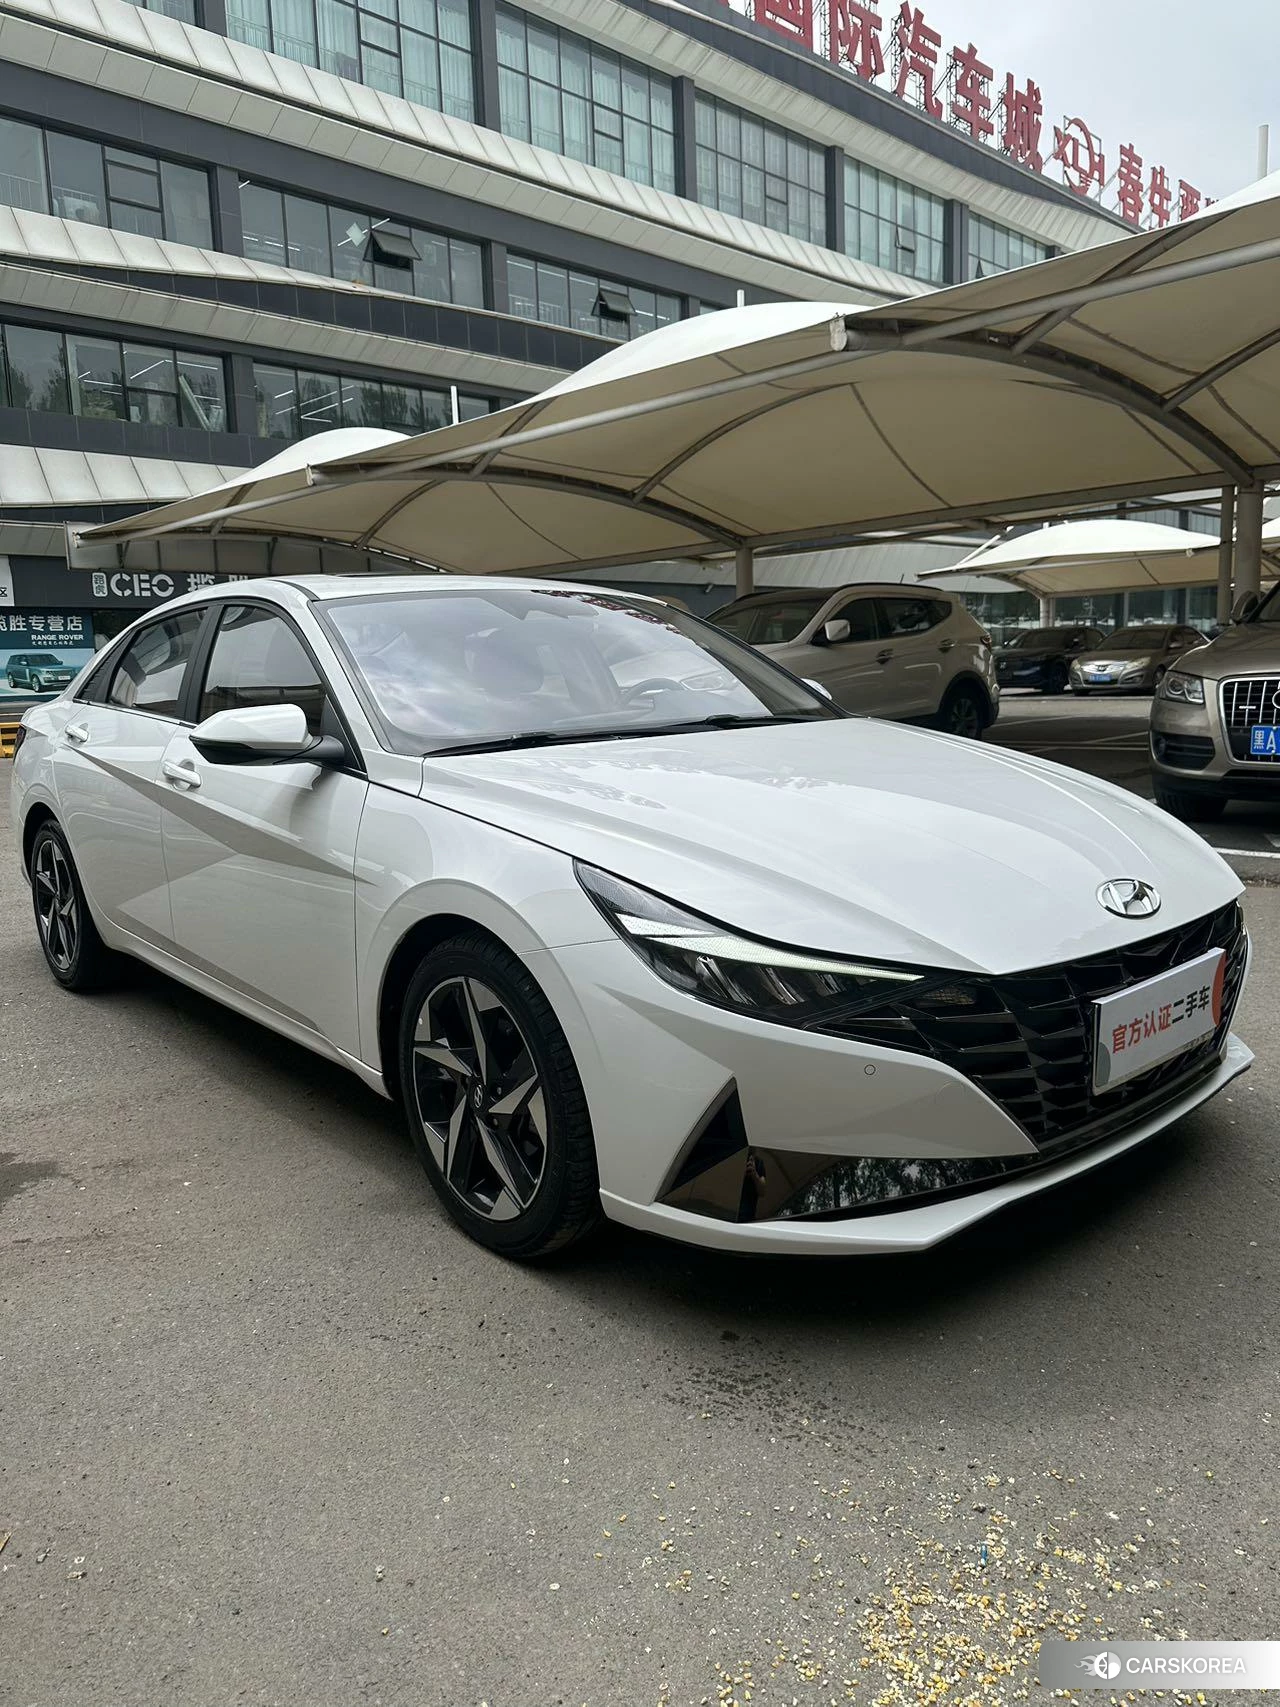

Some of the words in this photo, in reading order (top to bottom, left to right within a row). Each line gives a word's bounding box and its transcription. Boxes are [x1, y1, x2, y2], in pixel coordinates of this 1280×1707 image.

[110, 572, 175, 598] CEO
[1112, 985, 1211, 1054] 官方认证二手车
